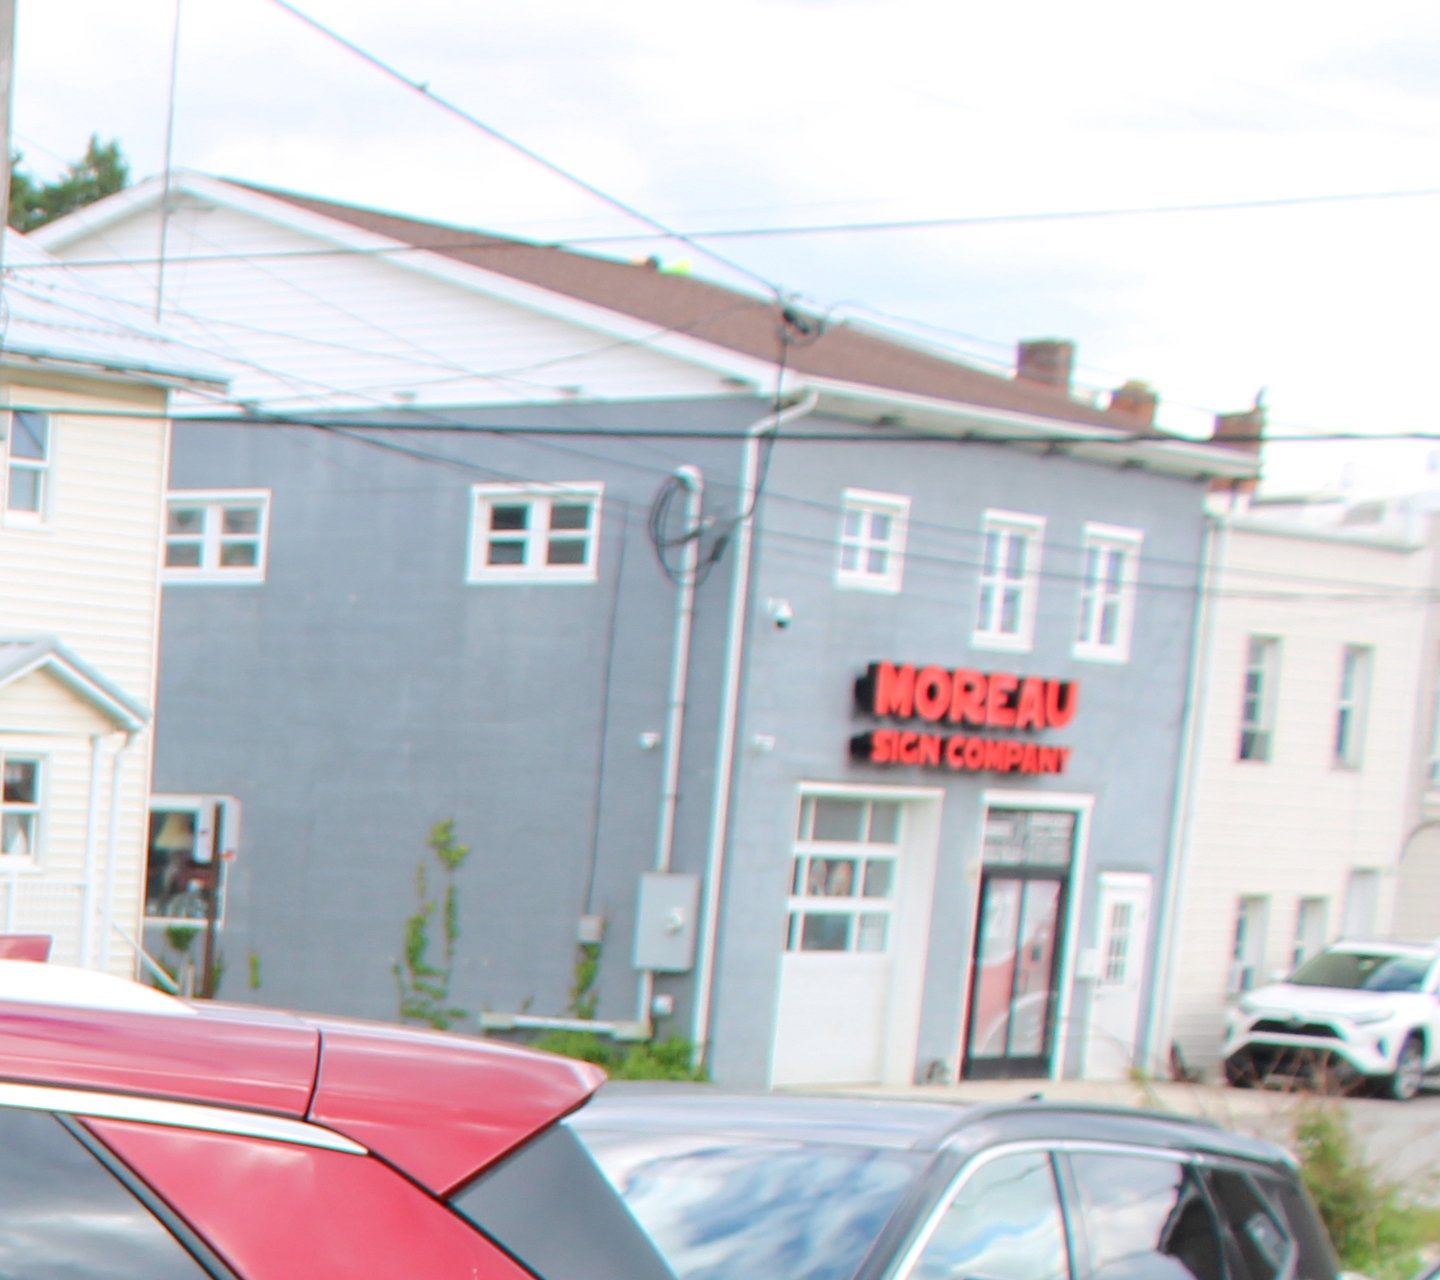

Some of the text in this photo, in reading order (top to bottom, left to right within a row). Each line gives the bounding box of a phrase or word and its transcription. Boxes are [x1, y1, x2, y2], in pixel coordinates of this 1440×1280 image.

[874, 660, 1079, 729] MOREAU
[871, 729, 1070, 773] SIGN COMPANY
